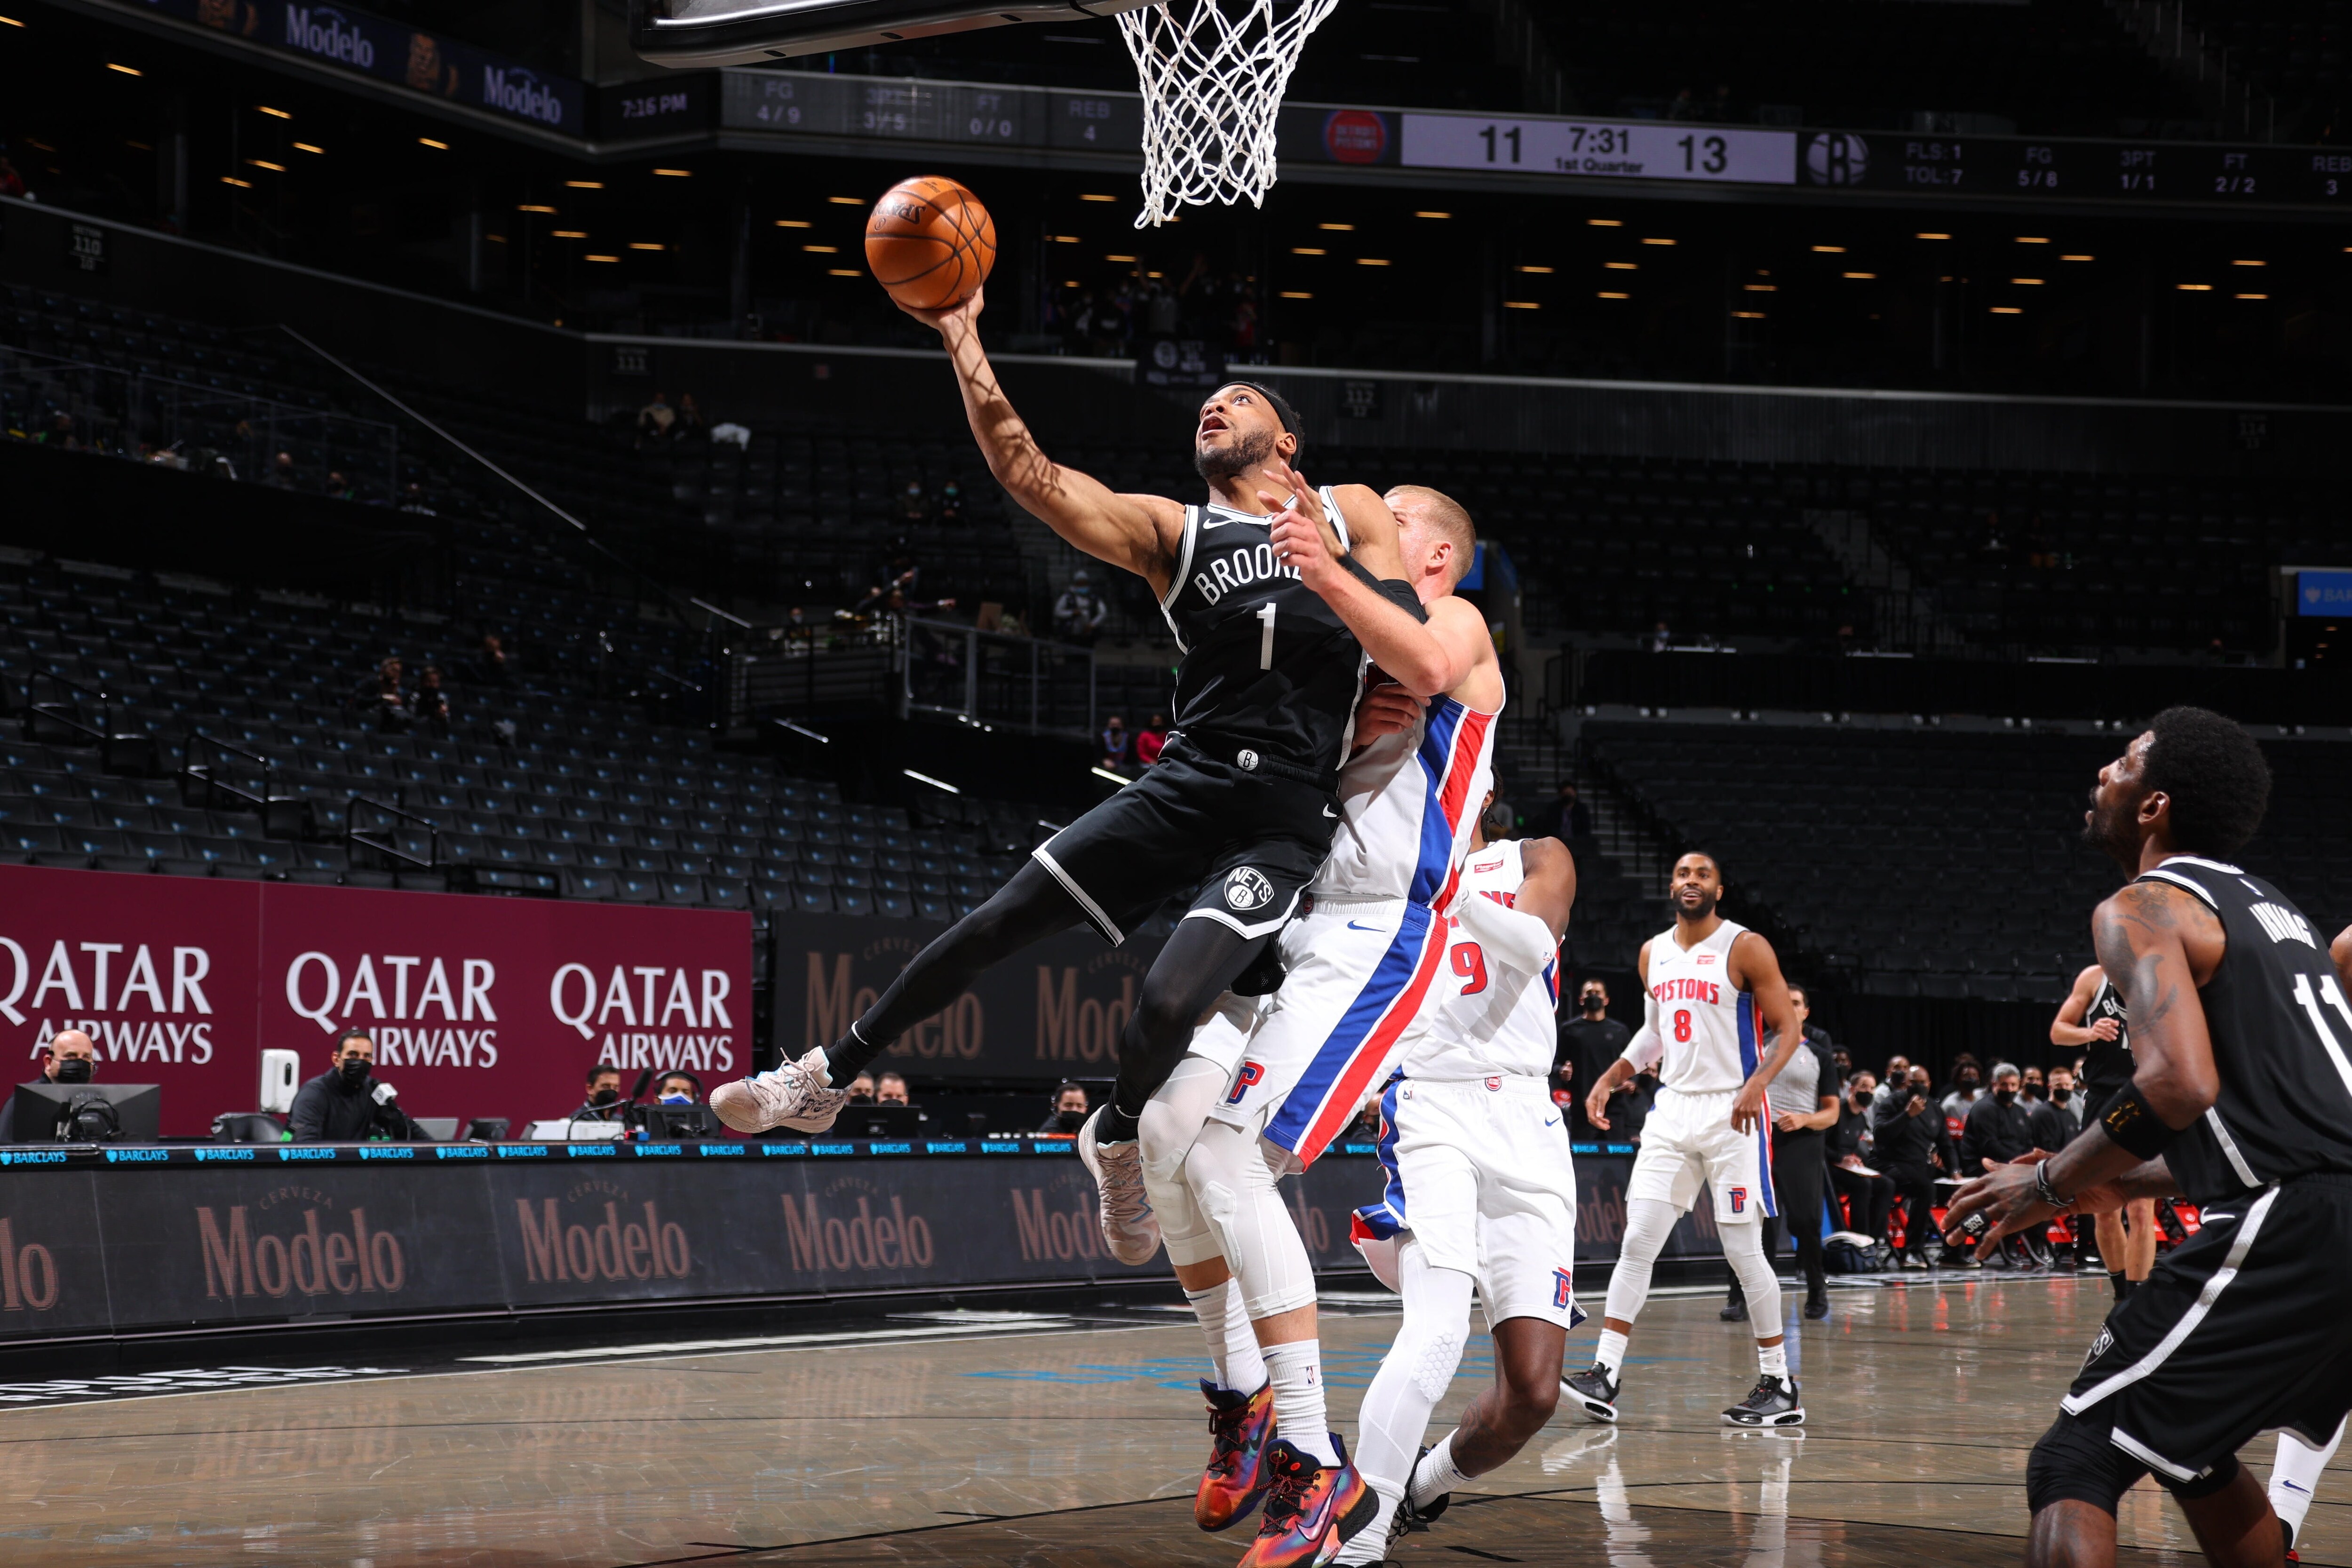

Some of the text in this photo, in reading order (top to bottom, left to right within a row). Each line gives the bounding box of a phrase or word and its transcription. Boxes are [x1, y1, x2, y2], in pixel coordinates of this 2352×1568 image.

[285, 3, 374, 68] Modelo
[483, 64, 562, 125] Modelo
[764, 81, 794, 99] FG
[620, 92, 688, 120] 7:16 PM
[977, 94, 1000, 112] FT
[1069, 100, 1111, 119] REB
[1083, 124, 1097, 142] 4
[1569, 127, 1629, 155] 7:31
[1479, 125, 1522, 164] 11
[1906, 142, 1962, 160] FLS: 1
[1677, 135, 1728, 174] 13
[2026, 146, 2053, 164] FG
[2120, 150, 2157, 167] 3PT
[2223, 153, 2249, 170] FT
[1555, 157, 1644, 175] 1st Quarter
[2312, 155, 2352, 173] REB
[1904, 166, 1964, 185] TOL: 7
[2325, 179, 2339, 196] 3
[73, 235, 103, 256] 110
[1256, 602, 1277, 671] 1
[1228, 868, 1271, 902] NETS
[1450, 942, 1488, 996] 9
[286, 951, 498, 1035] QATAR
[1653, 979, 1720, 1005] PISTONS
[550, 963, 733, 1041] QATAR
[1674, 1009, 1692, 1043] 8
[2293, 973, 2352, 1097] 11
[368, 1027, 498, 1068] IRWAYS
[597, 1032, 734, 1072] AIRWAYS
[119, 1149, 169, 1161] BARCLAYS
[207, 1148, 255, 1160] BARCLAYS
[290, 1148, 336, 1159] BARCLAYS
[370, 1147, 414, 1158] BARCLAYS
[446, 1146, 489, 1157] BARCLAYS
[508, 1146, 548, 1156] BARCLAYS
[577, 1145, 616, 1155] BARCLAYS
[644, 1145, 682, 1155] BARCLAYS
[709, 1144, 745, 1155] BARCLAYS
[771, 1144, 806, 1154] BARCLAYS
[820, 1144, 854, 1154] BARCLAYS
[878, 1143, 911, 1154] BARCLAYS
[935, 1142, 967, 1153] BARCLAYS
[989, 1142, 1020, 1152] BARCLAYS
[1042, 1142, 1072, 1153] BARCLAYS
[14, 1151, 67, 1163] BARCLAYS
[567, 1180, 629, 1203] CERVEZA
[825, 1177, 879, 1198] CERVEZA
[259, 1186, 333, 1210] CERVEZA
[515, 1198, 692, 1284] Modelo
[780, 1193, 935, 1273] Modelo
[195, 1206, 405, 1299] Modelo
